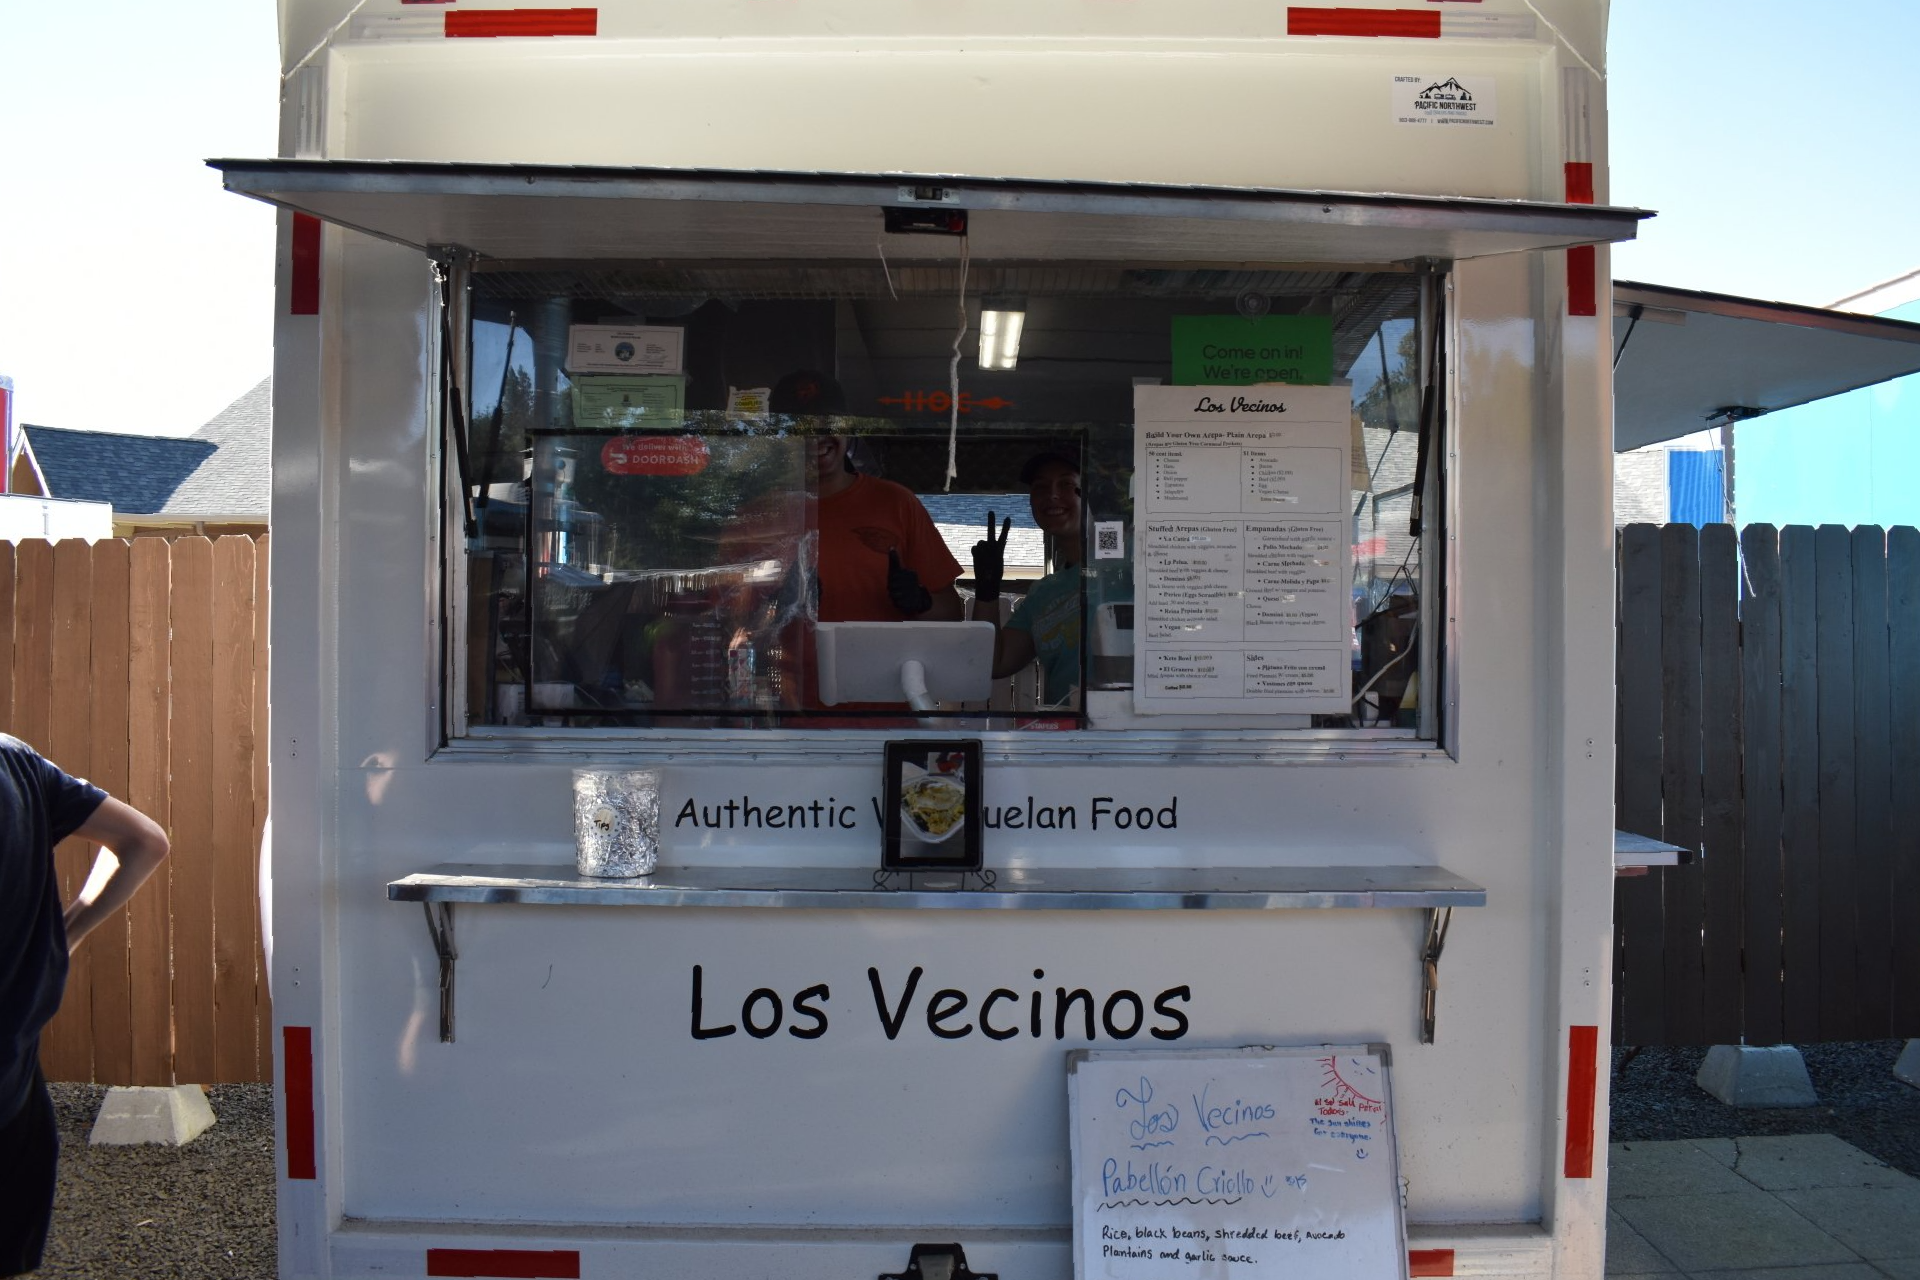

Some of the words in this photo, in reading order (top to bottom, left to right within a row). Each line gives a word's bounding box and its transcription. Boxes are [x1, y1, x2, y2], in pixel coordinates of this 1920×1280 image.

[1415, 101, 1438, 110] PACIFIC
[1439, 102, 1476, 110] NORTHWEST
[1202, 344, 1255, 360] Come
[1260, 347, 1280, 360] on
[1284, 346, 1303, 360] in!
[1203, 366, 1251, 380] We're
[1255, 368, 1303, 382] open.
[1194, 396, 1226, 413] Los
[1230, 396, 1287, 413] Vecinos
[1246, 432, 1266, 440] Arepa
[632, 455, 699, 464] DOORDASH
[1246, 525, 1286, 533] Empanadas
[674, 796, 856, 830] Authentic
[1090, 796, 1178, 830] Food
[690, 963, 831, 1041] Los
[867, 965, 1192, 1041] Vecinos
[1116, 1076, 1179, 1140] Los
[1193, 1083, 1275, 1132] Vecinos
[1102, 1157, 1187, 1197] Pabellón
[1197, 1166, 1254, 1194] Criollo
[1101, 1225, 1132, 1240] Rice,
[1135, 1226, 1167, 1239] black
[1172, 1226, 1210, 1242] beans,
[1102, 1245, 1153, 1259] Plantains
[1159, 1248, 1180, 1260] and
[1184, 1248, 1216, 1264] garlic
[1221, 1253, 1258, 1264] sauce.
